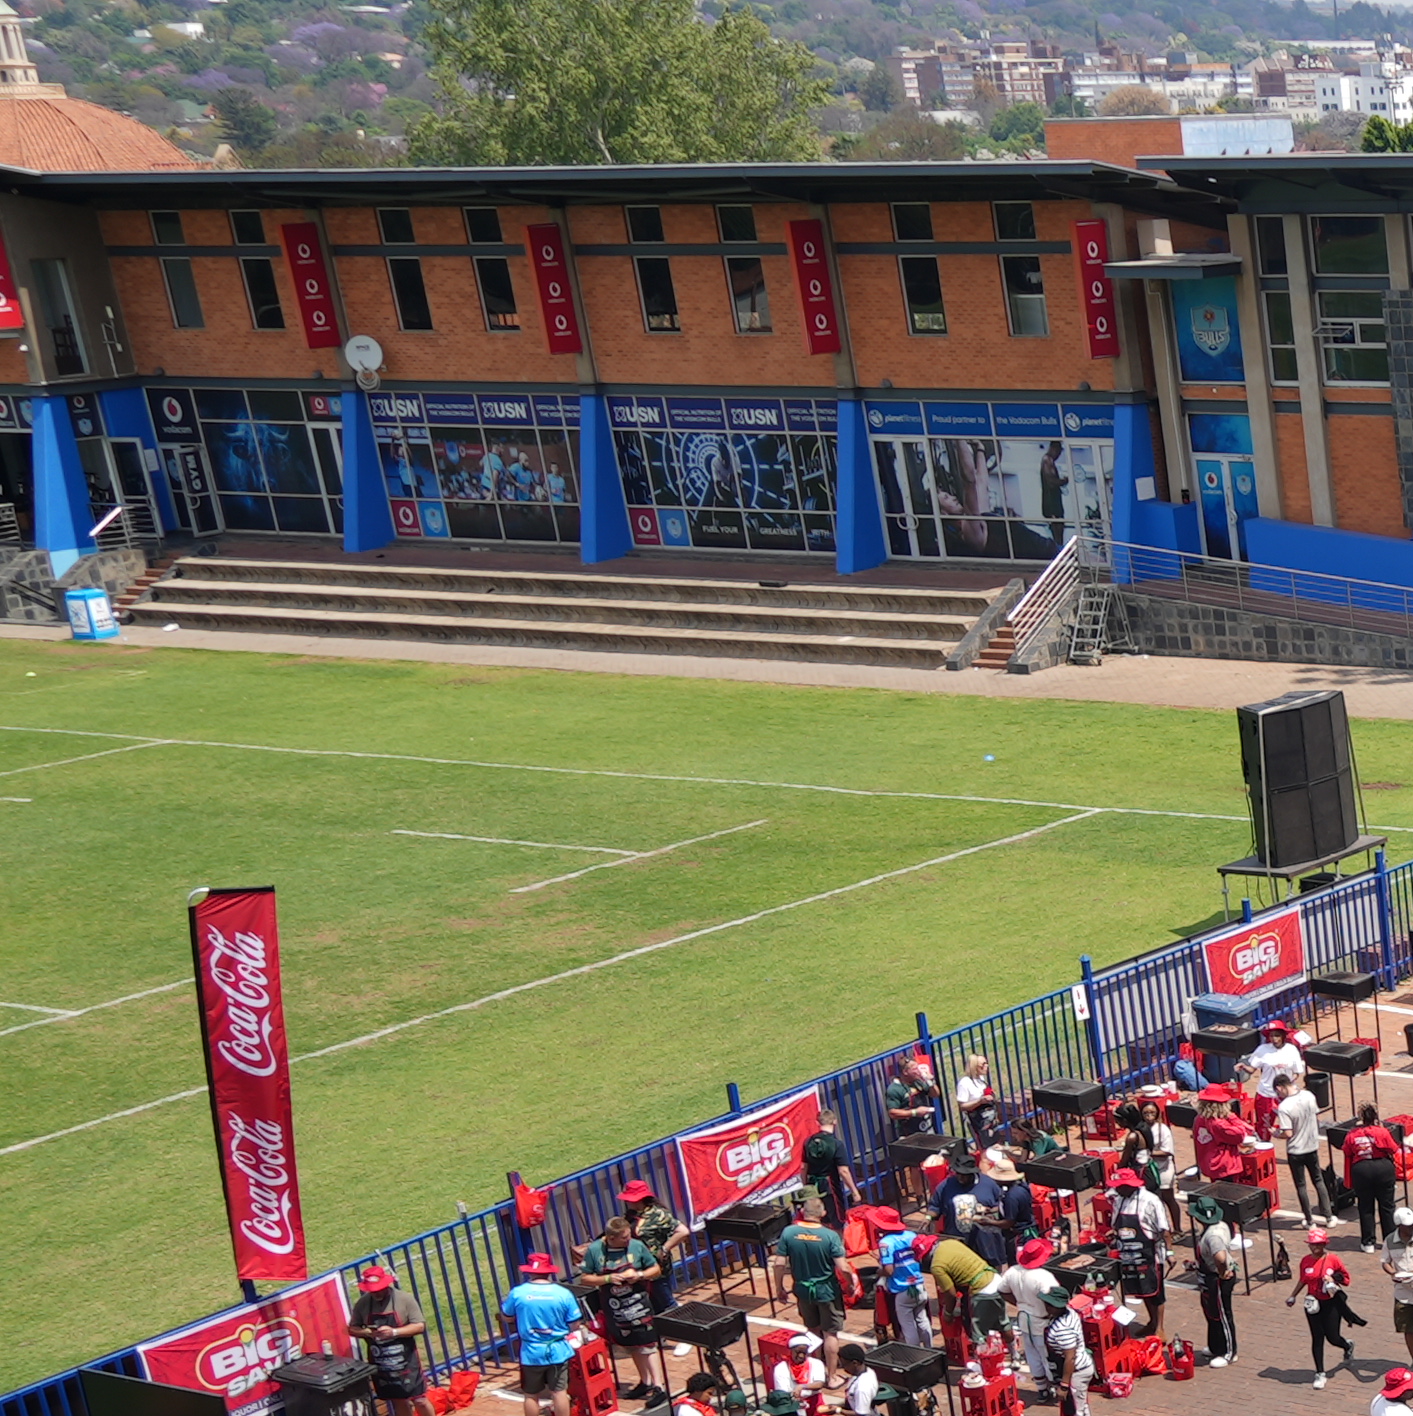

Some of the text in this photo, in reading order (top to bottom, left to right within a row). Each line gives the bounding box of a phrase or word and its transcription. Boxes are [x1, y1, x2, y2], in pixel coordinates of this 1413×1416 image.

[385, 399, 420, 418] USN
[495, 402, 528, 419] USN
[626, 406, 661, 423] USN
[743, 408, 778, 426] USN
[931, 414, 985, 425] Proud partner to
[996, 415, 1057, 425] the Vodacom Bulls
[185, 454, 202, 490] GYM
[720, 525, 738, 534] YOUR
[1235, 939, 1277, 971] BIG
[1243, 954, 1280, 984] SAVE
[208, 924, 277, 1077] Coca-Cola
[726, 1132, 786, 1172] BIG
[227, 1110, 296, 1255] Coca-Cola
[737, 1147, 792, 1188] SAVE
[211, 1328, 294, 1380] BIG
